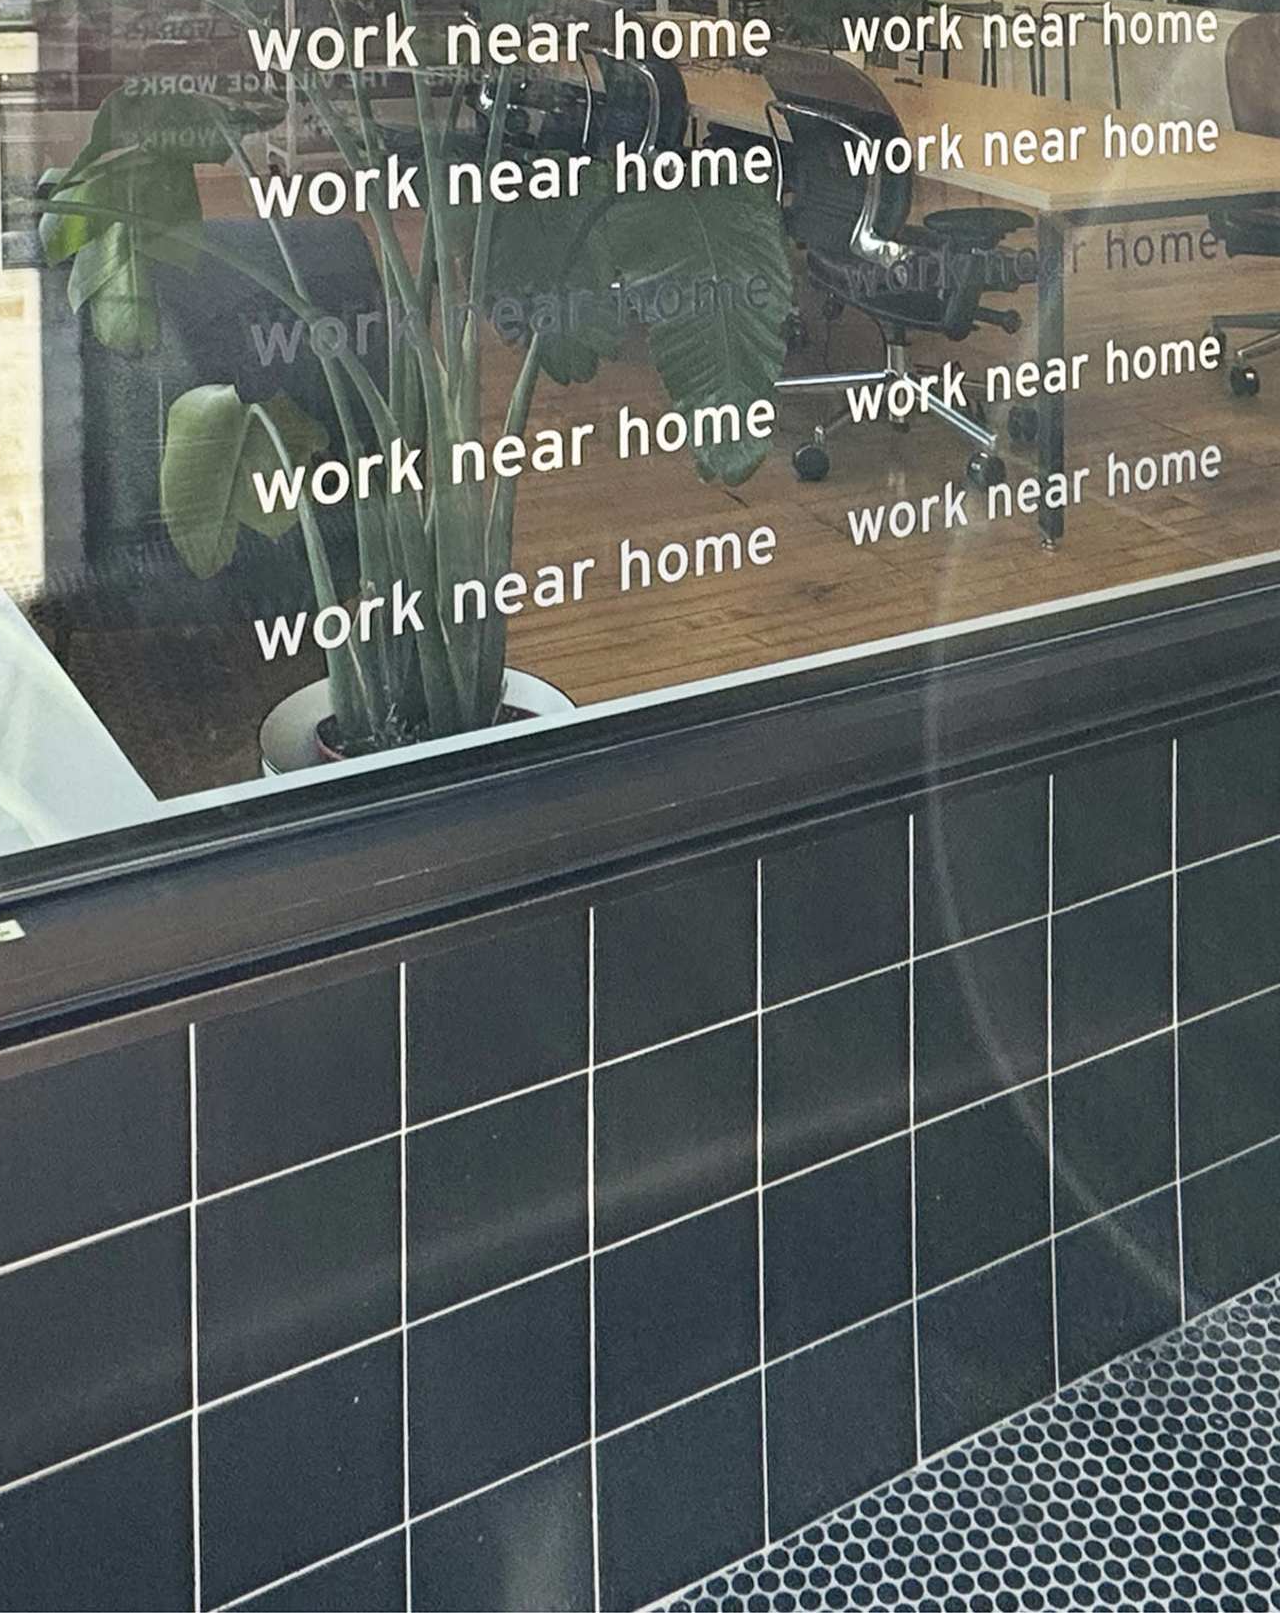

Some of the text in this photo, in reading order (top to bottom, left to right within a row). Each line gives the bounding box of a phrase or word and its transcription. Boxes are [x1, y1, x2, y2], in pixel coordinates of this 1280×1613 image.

[248, 9, 772, 71] work near home
[842, 2, 1218, 53] work near home
[249, 141, 773, 220] work near home
[843, 113, 1220, 177] work near home
[1106, 225, 1220, 269] home
[250, 299, 421, 367] work
[846, 336, 1221, 423] work near home
[252, 399, 776, 514] work near home
[848, 444, 1222, 547] work near home
[254, 526, 777, 662] work near home
